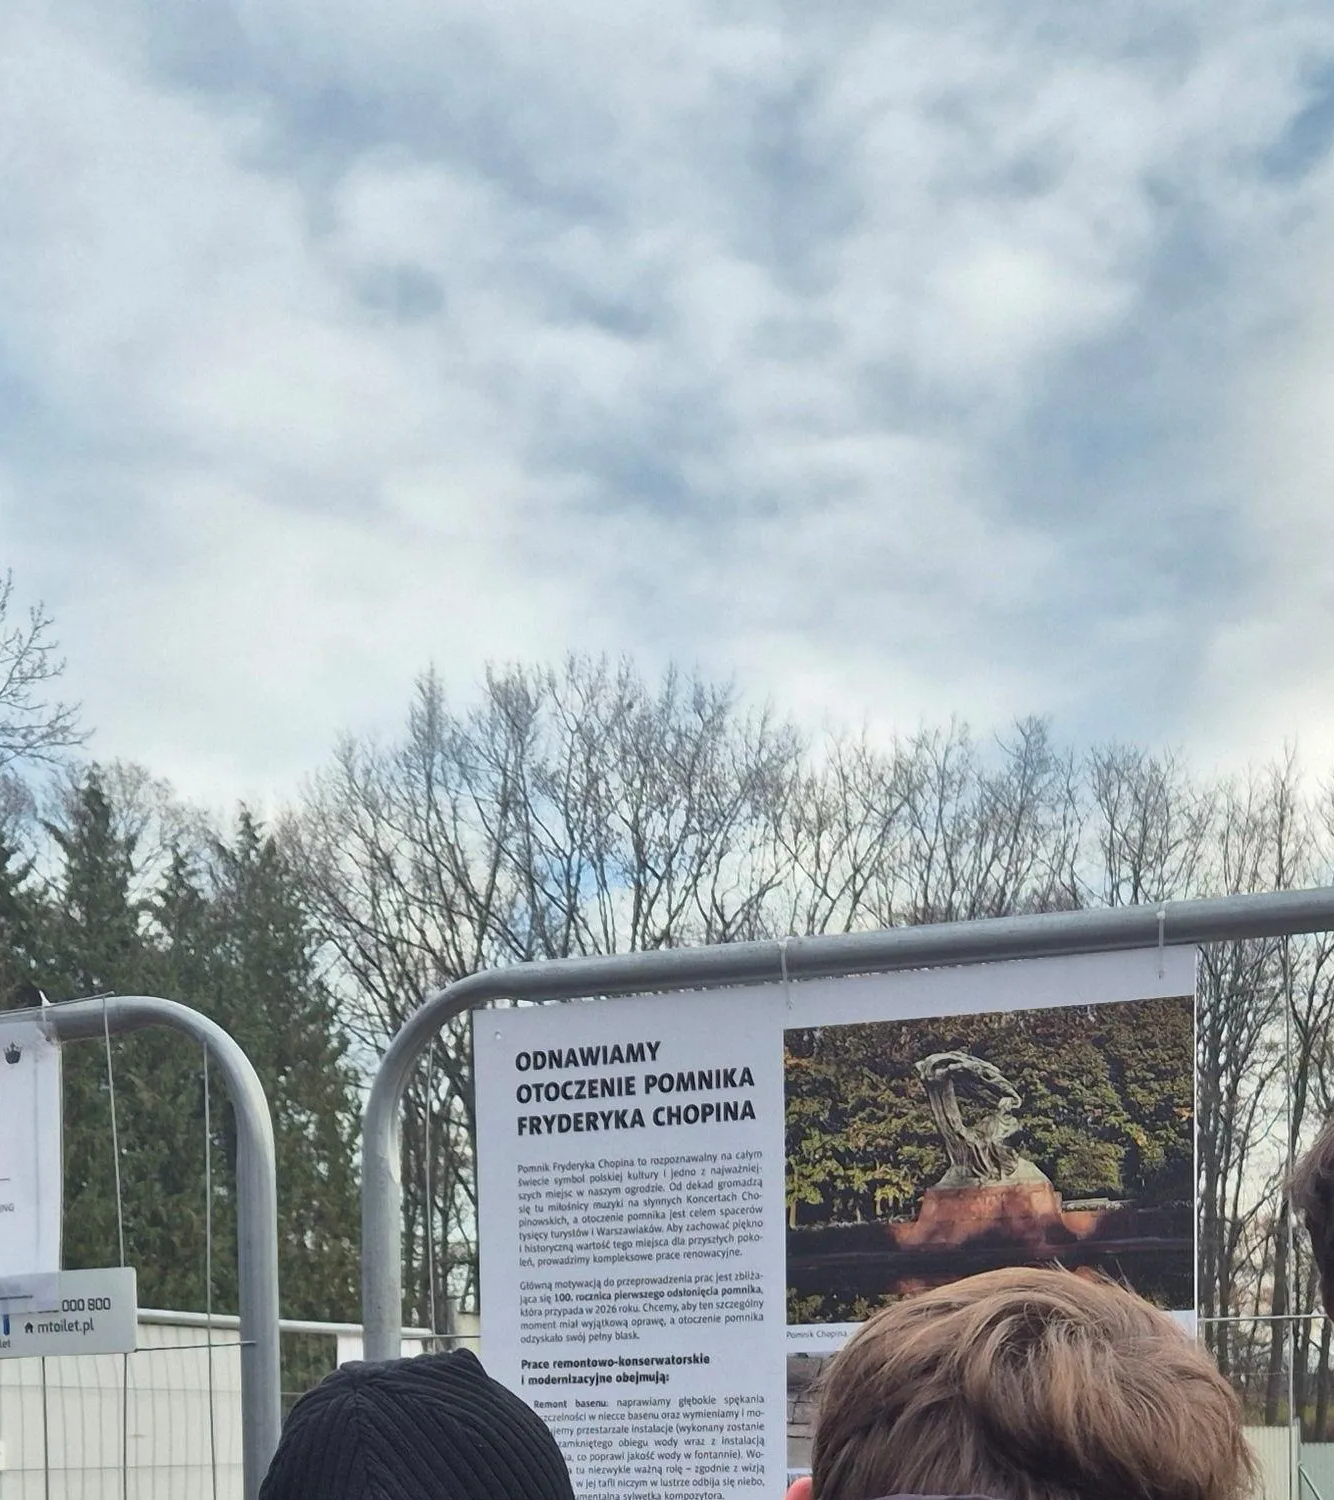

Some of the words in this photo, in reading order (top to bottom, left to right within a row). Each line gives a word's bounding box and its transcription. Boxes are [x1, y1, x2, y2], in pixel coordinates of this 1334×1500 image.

[516, 1041, 660, 1072] ODNAWIAMY
[516, 1075, 636, 1104] OTOCZENIE
[644, 1067, 755, 1095] POMNIKA
[517, 1108, 646, 1136] FRYDERYKA
[652, 1100, 756, 1127] CHOPINA
[61, 1299, 85, 1312] 000
[37, 1317, 94, 1335] mtoilet.pl
[521, 1359, 550, 1370] Prace
[552, 1352, 710, 1369] remontowo-konserwatorskie
[528, 1372, 613, 1387] modernizacyjne
[615, 1370, 669, 1385] obejmują:
